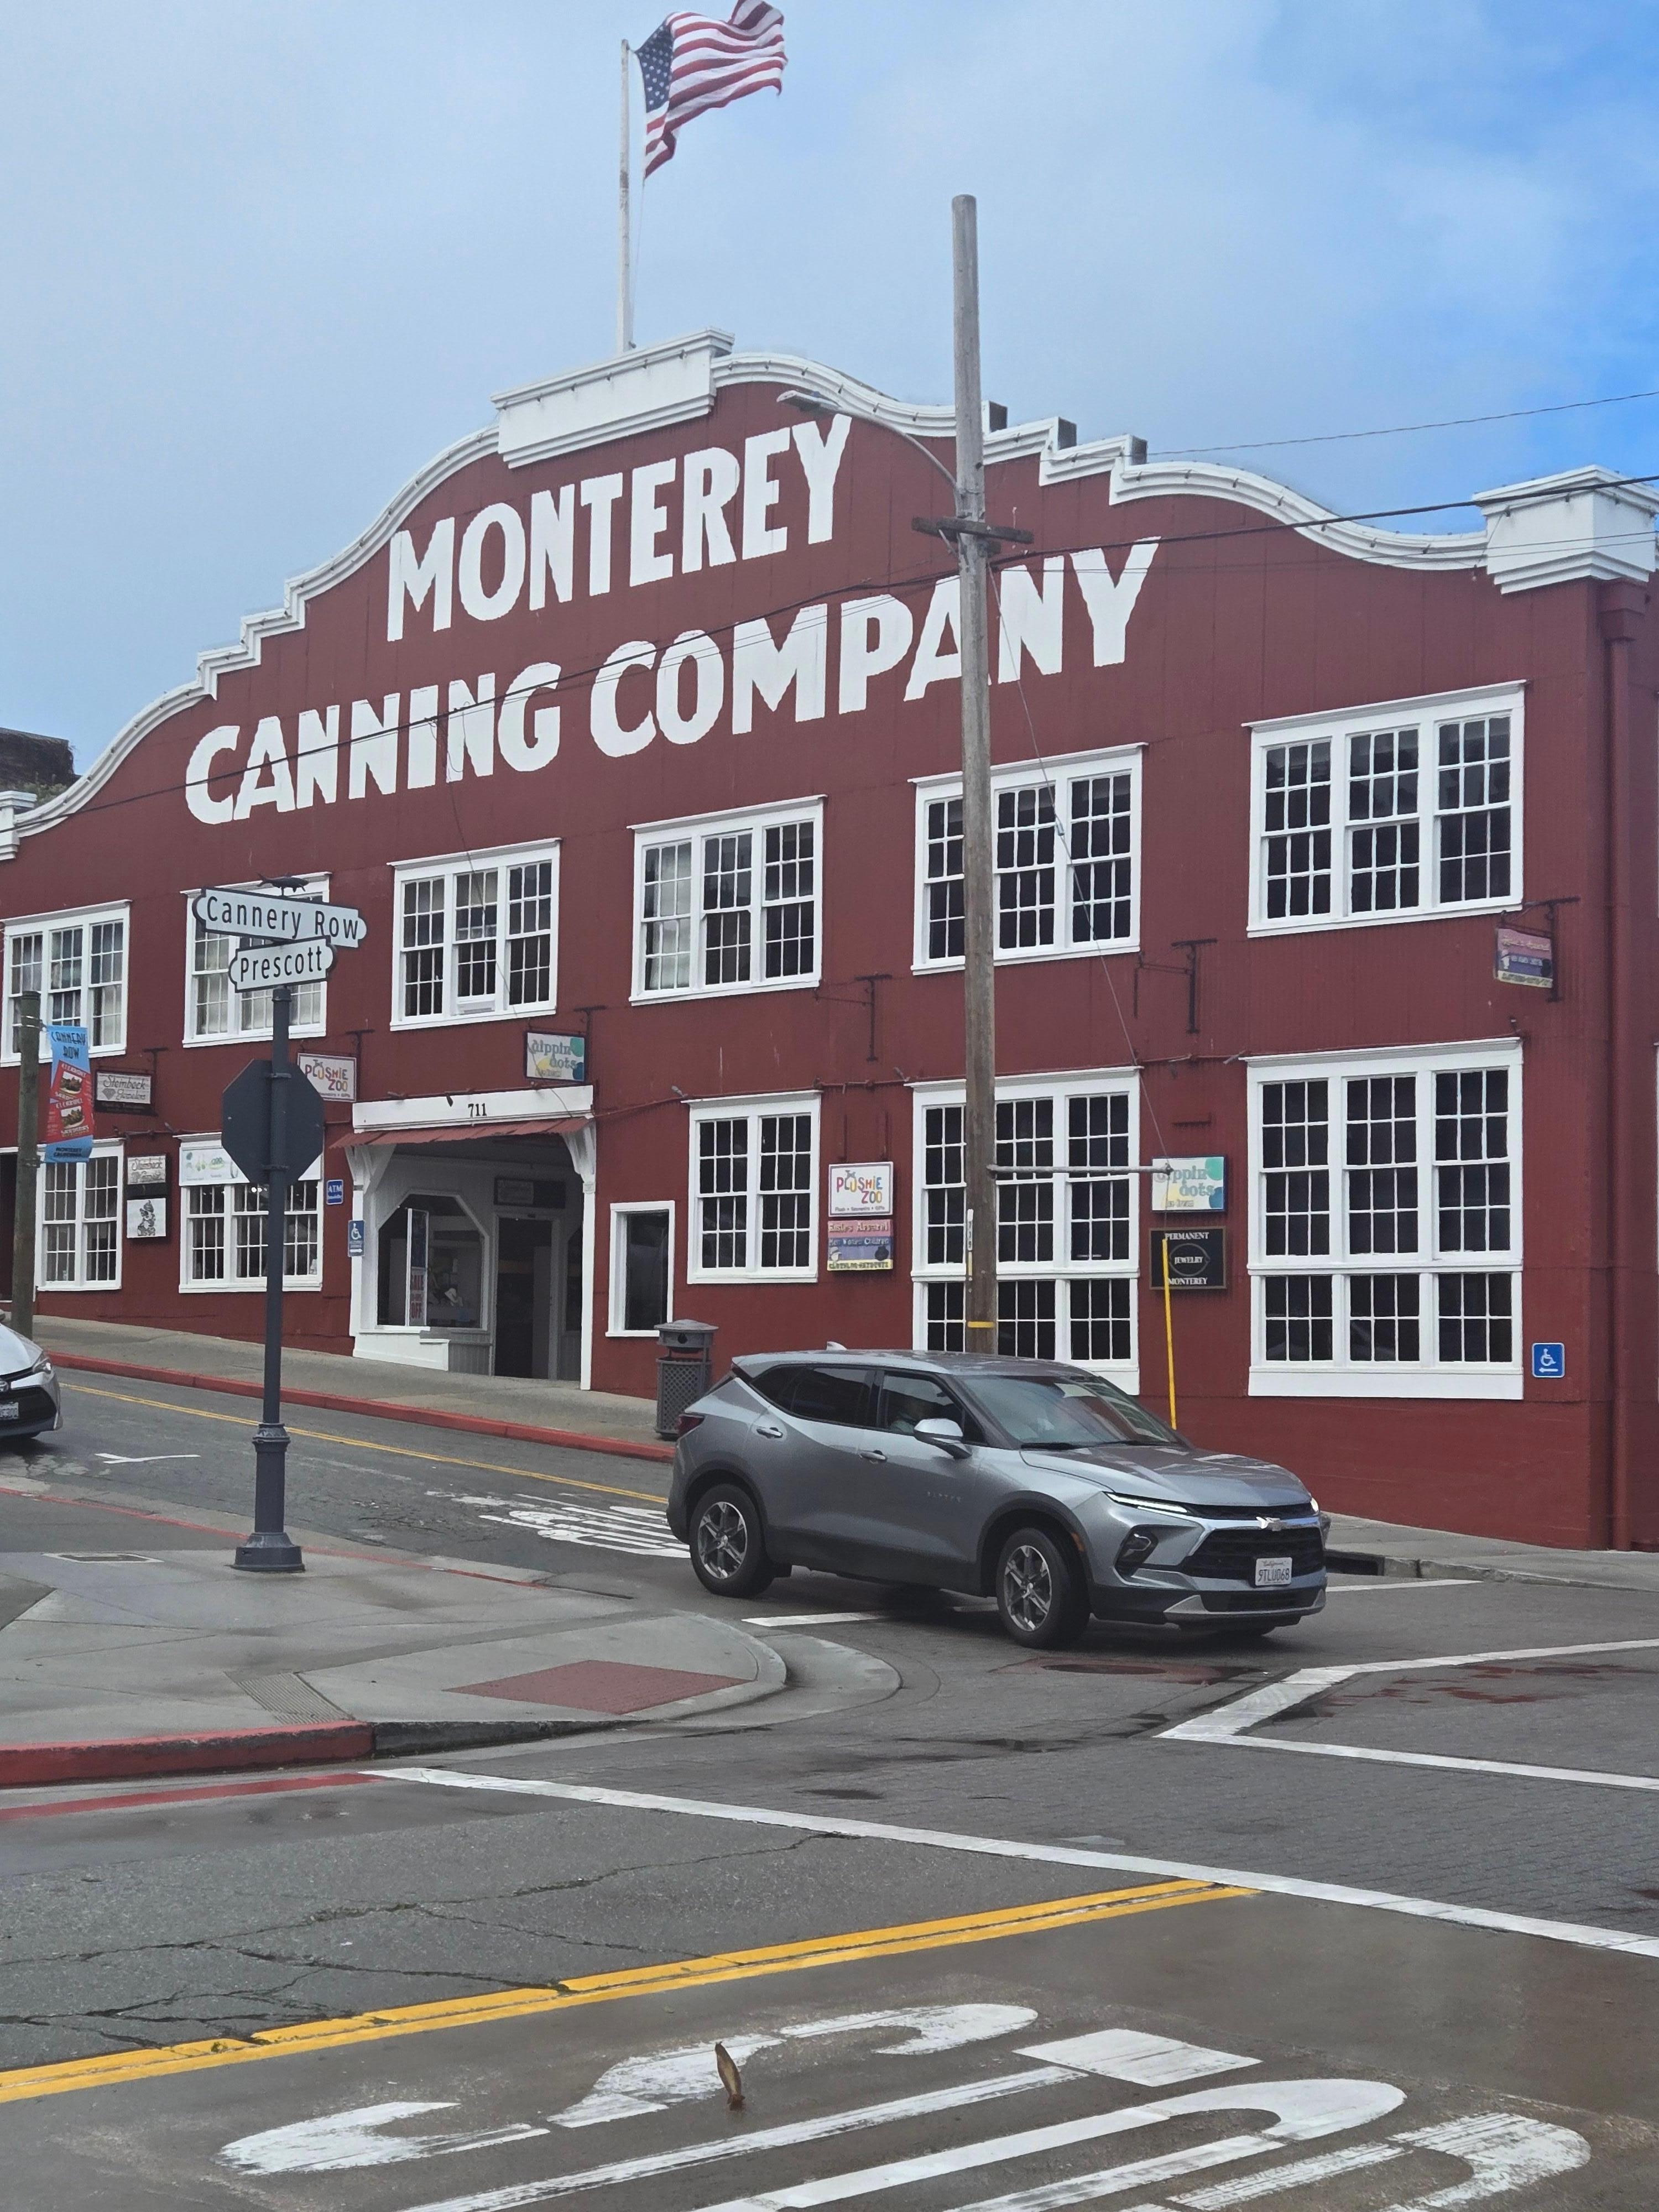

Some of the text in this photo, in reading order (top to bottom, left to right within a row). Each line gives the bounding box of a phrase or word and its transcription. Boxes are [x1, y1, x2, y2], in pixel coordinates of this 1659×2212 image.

[388, 414, 852, 641] MONTEREY
[186, 536, 1161, 825] CANNING COMPANY
[207, 896, 358, 940] Cannery Row
[240, 946, 322, 982] Prescott
[328, 1079, 348, 1092] ZOO
[468, 1103, 487, 1118] 711
[837, 1176, 883, 1192] PLUSHIE
[1179, 1182, 1215, 1197] dots
[862, 1191, 882, 1203] ZOO
[1164, 1232, 1209, 1240] PERMANENT
[1174, 1256, 1203, 1265] JEWELRY
[1167, 1277, 1208, 1286] MONTEREY
